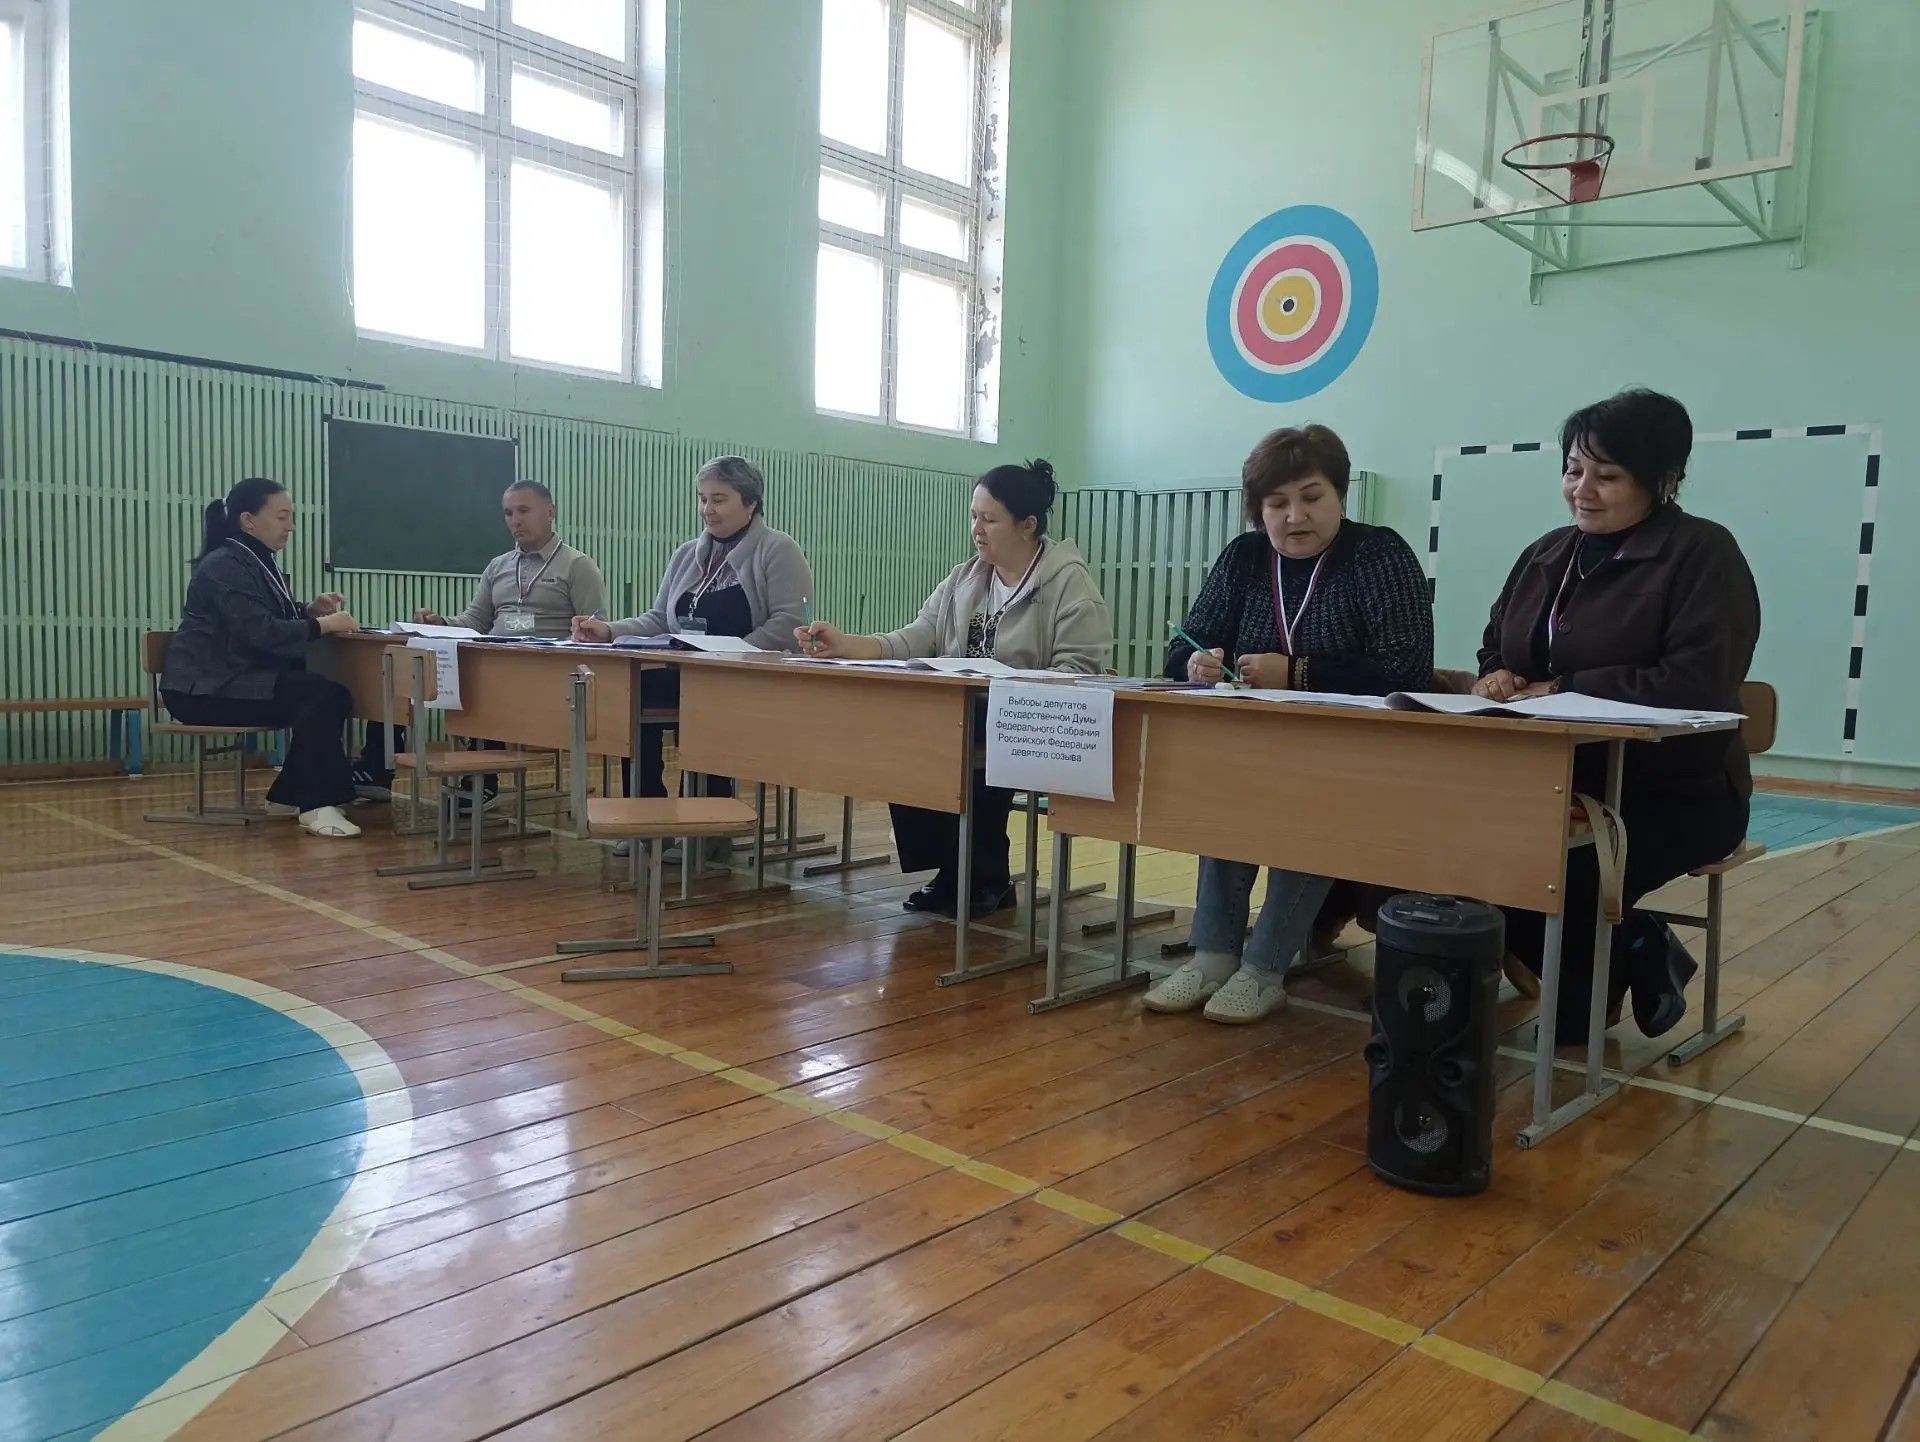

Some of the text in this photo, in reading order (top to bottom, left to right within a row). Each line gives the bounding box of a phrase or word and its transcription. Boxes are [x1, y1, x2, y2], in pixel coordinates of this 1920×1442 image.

[1009, 696, 1087, 711] Выборы депутатов
[1000, 708, 1096, 725] Государственной Думы
[996, 721, 1099, 737] Федерального Собрания
[998, 733, 1096, 750] Российской Федерации
[1011, 748, 1081, 762] девятого созыва
